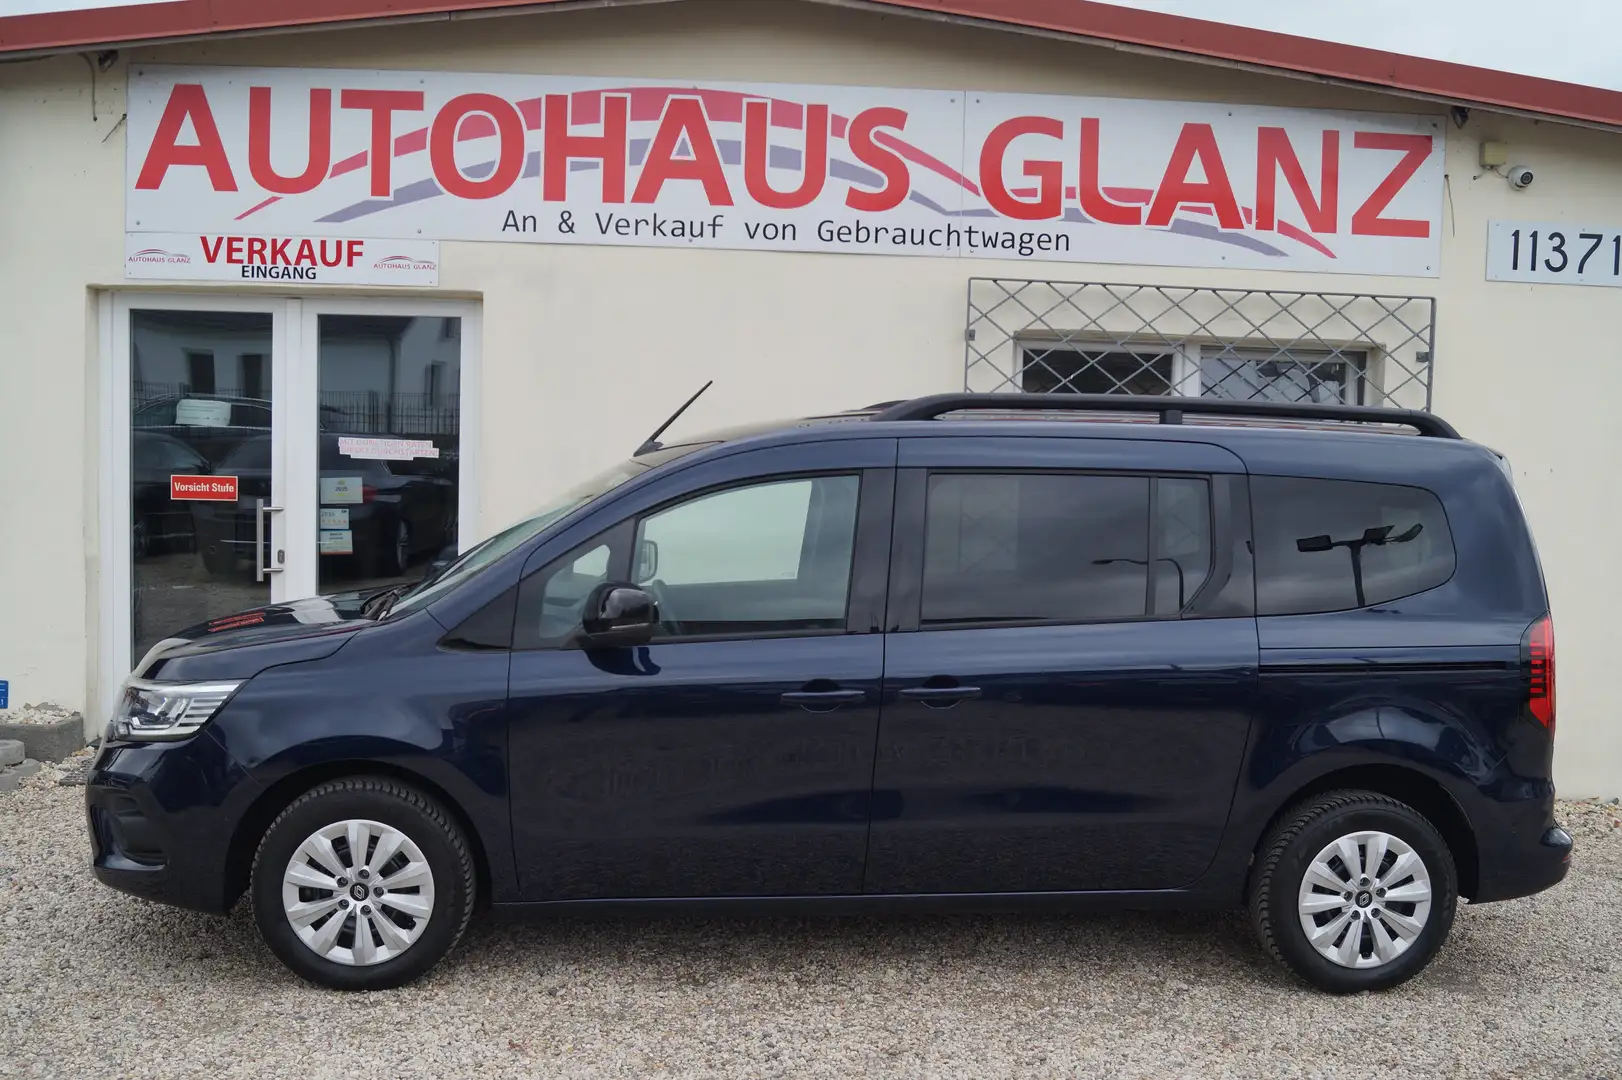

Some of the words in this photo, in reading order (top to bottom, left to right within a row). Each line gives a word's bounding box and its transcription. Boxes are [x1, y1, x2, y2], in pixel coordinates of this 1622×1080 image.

[135, 83, 911, 213] AUTOHAUS
[980, 114, 1433, 239] GLANZ
[200, 236, 364, 268] VERKAUF
[501, 209, 537, 233] An
[558, 210, 576, 234] &
[595, 212, 724, 239] Verkauf
[744, 221, 796, 241] von
[817, 219, 1070, 257] Gebrauchtwagen
[1511, 229, 1621, 276] 11371
[241, 265, 317, 280] EINGANG
[174, 481, 210, 492] Vorsicht
[211, 482, 235, 493] Stufe
